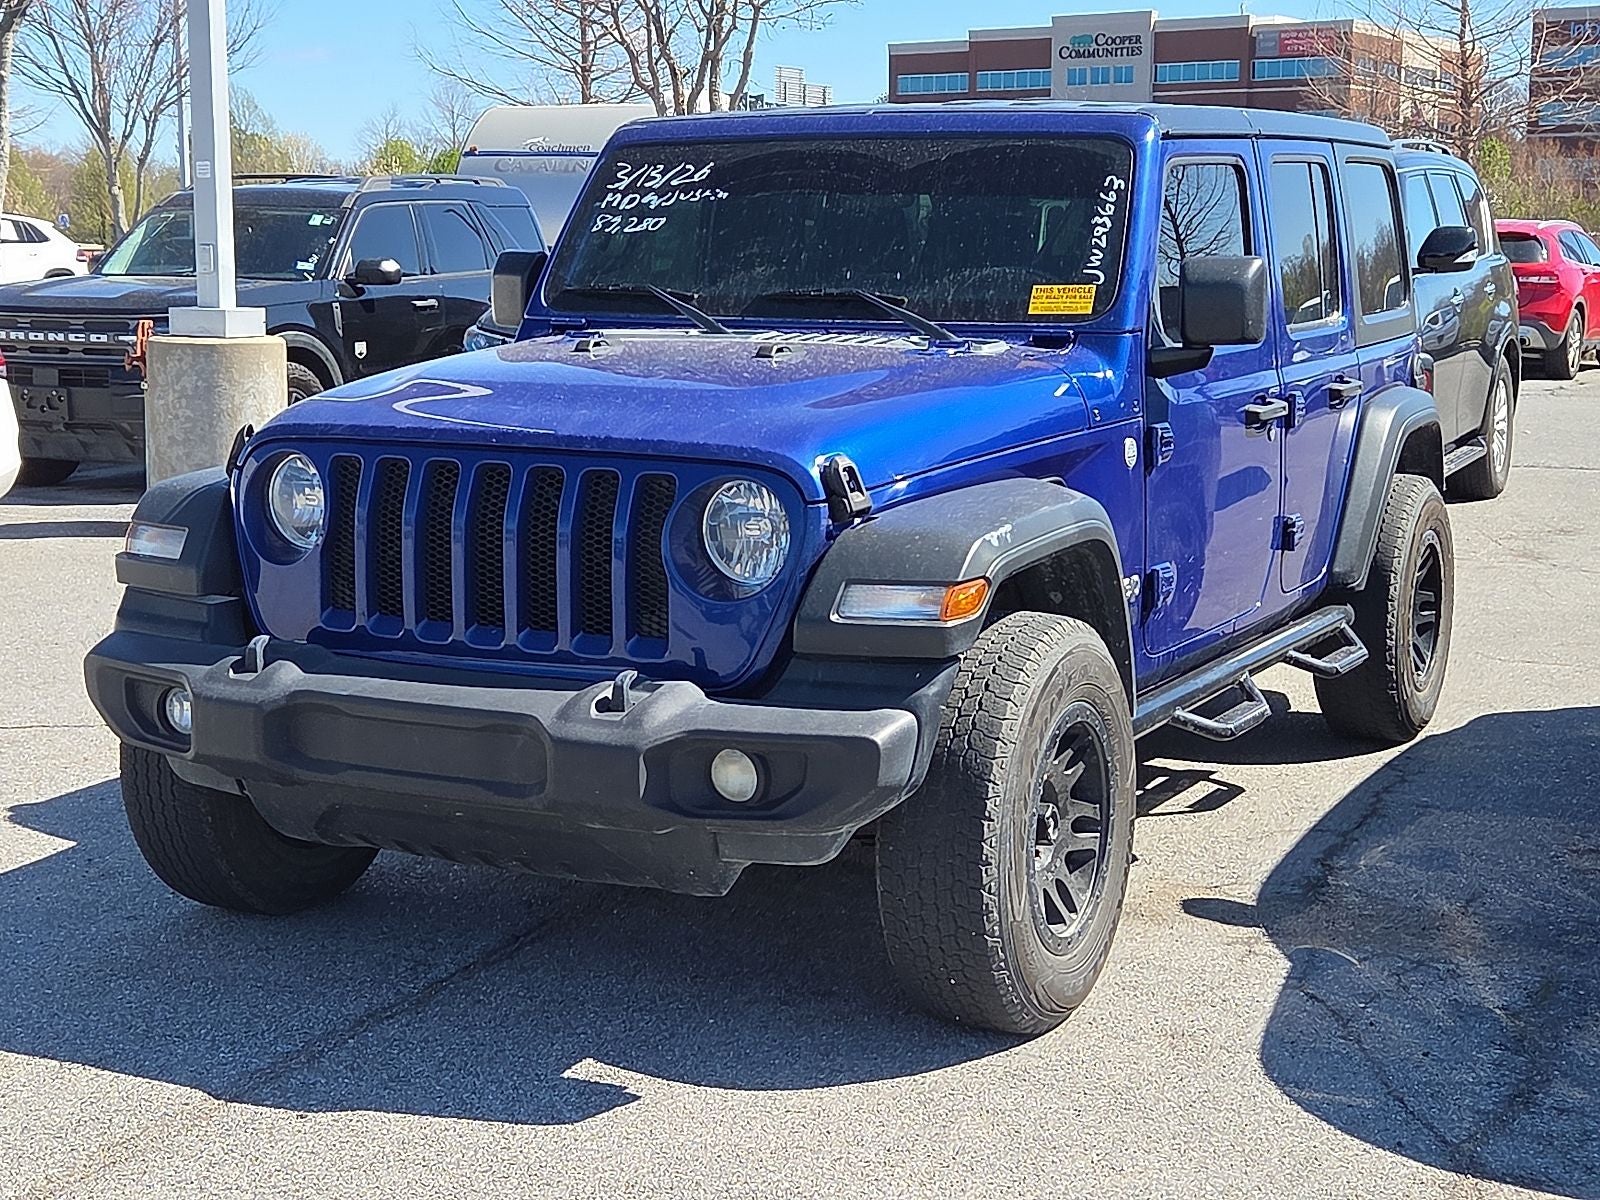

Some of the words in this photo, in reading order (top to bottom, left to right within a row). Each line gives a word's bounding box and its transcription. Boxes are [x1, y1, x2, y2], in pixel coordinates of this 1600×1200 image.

[1094, 33, 1143, 47] COOPER
[1058, 45, 1143, 60] COMMUNITIES
[528, 143, 591, 153] Coachmen
[606, 162, 715, 190] 3/13/26
[1057, 286, 1094, 294] VEHICLE
